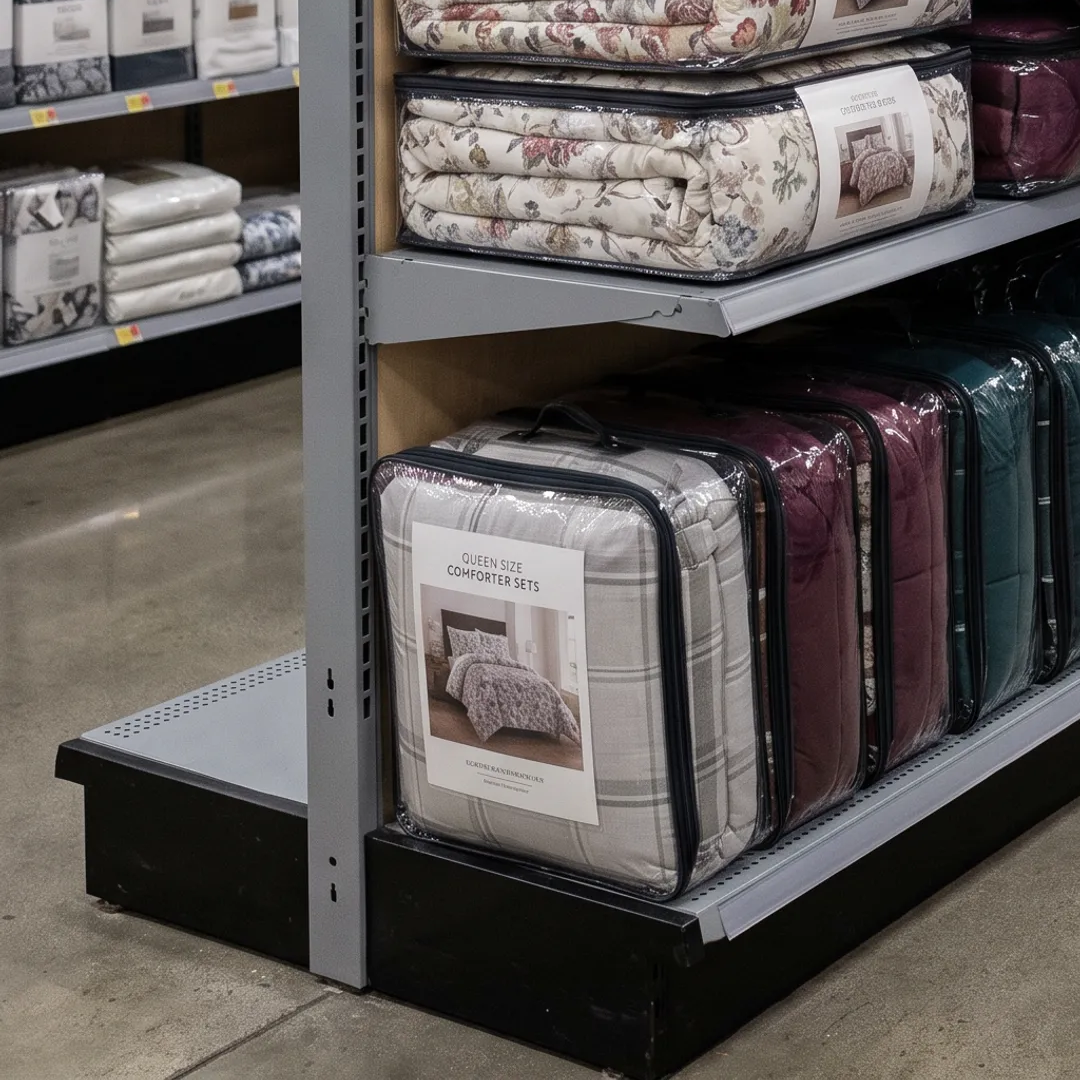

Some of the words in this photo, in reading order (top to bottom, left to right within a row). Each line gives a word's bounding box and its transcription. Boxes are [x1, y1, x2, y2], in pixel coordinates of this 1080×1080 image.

[461, 552, 498, 569] QUEEN
[500, 559, 523, 574] SIZE
[447, 564, 512, 587] COMFORTER
[514, 577, 540, 593] SETS
